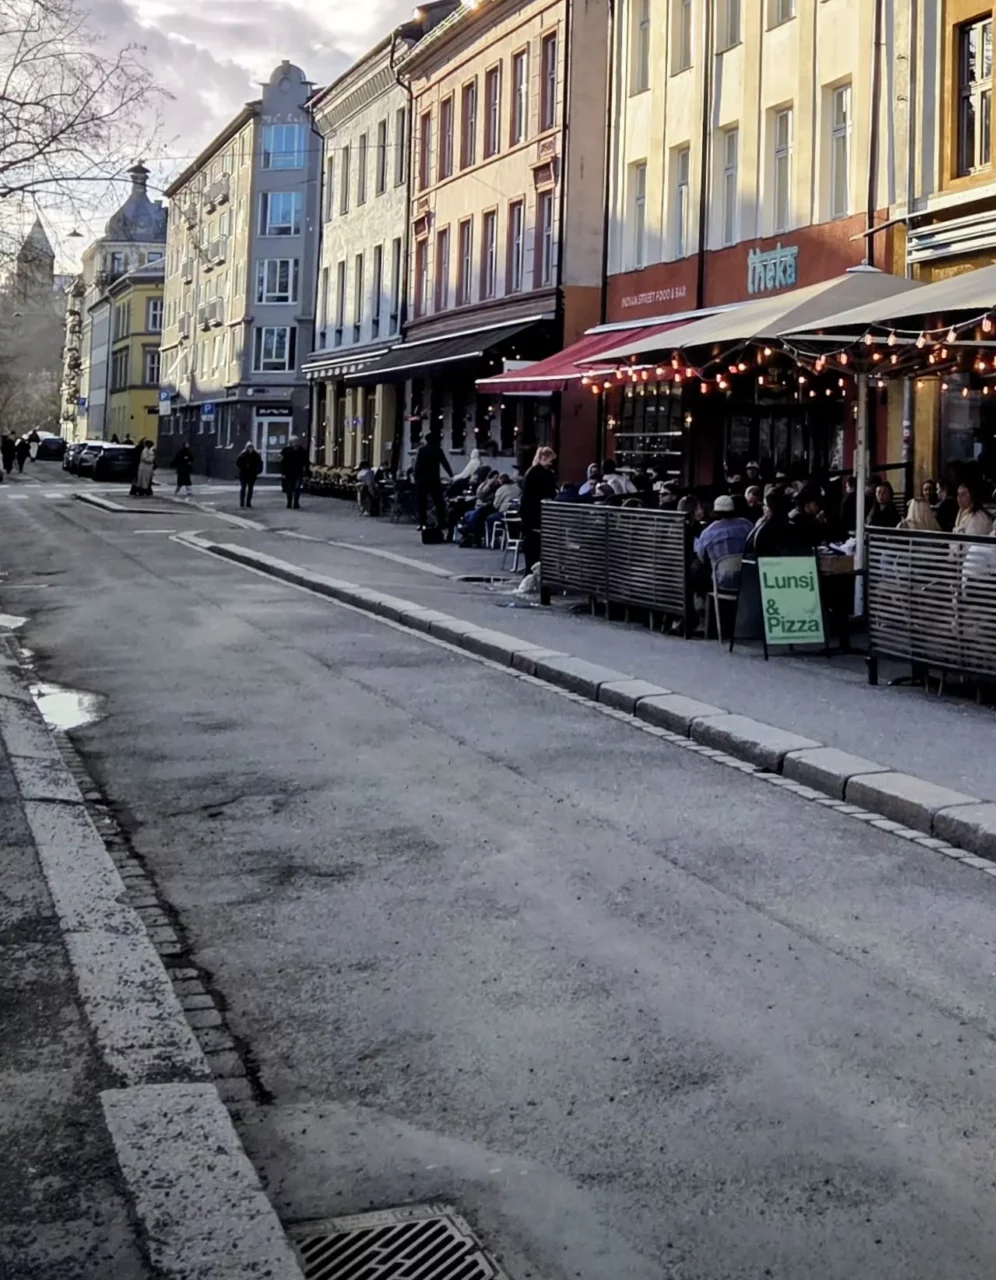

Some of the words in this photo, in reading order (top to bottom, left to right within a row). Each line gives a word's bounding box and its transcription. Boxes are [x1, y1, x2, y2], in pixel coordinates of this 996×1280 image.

[747, 242, 799, 294] theka
[638, 291, 656, 304] STREET
[656, 288, 670, 302] FOOD
[675, 285, 686, 299] BAR
[763, 571, 815, 592] Lunsj
[766, 598, 780, 616] &
[767, 616, 820, 634] Pizza
